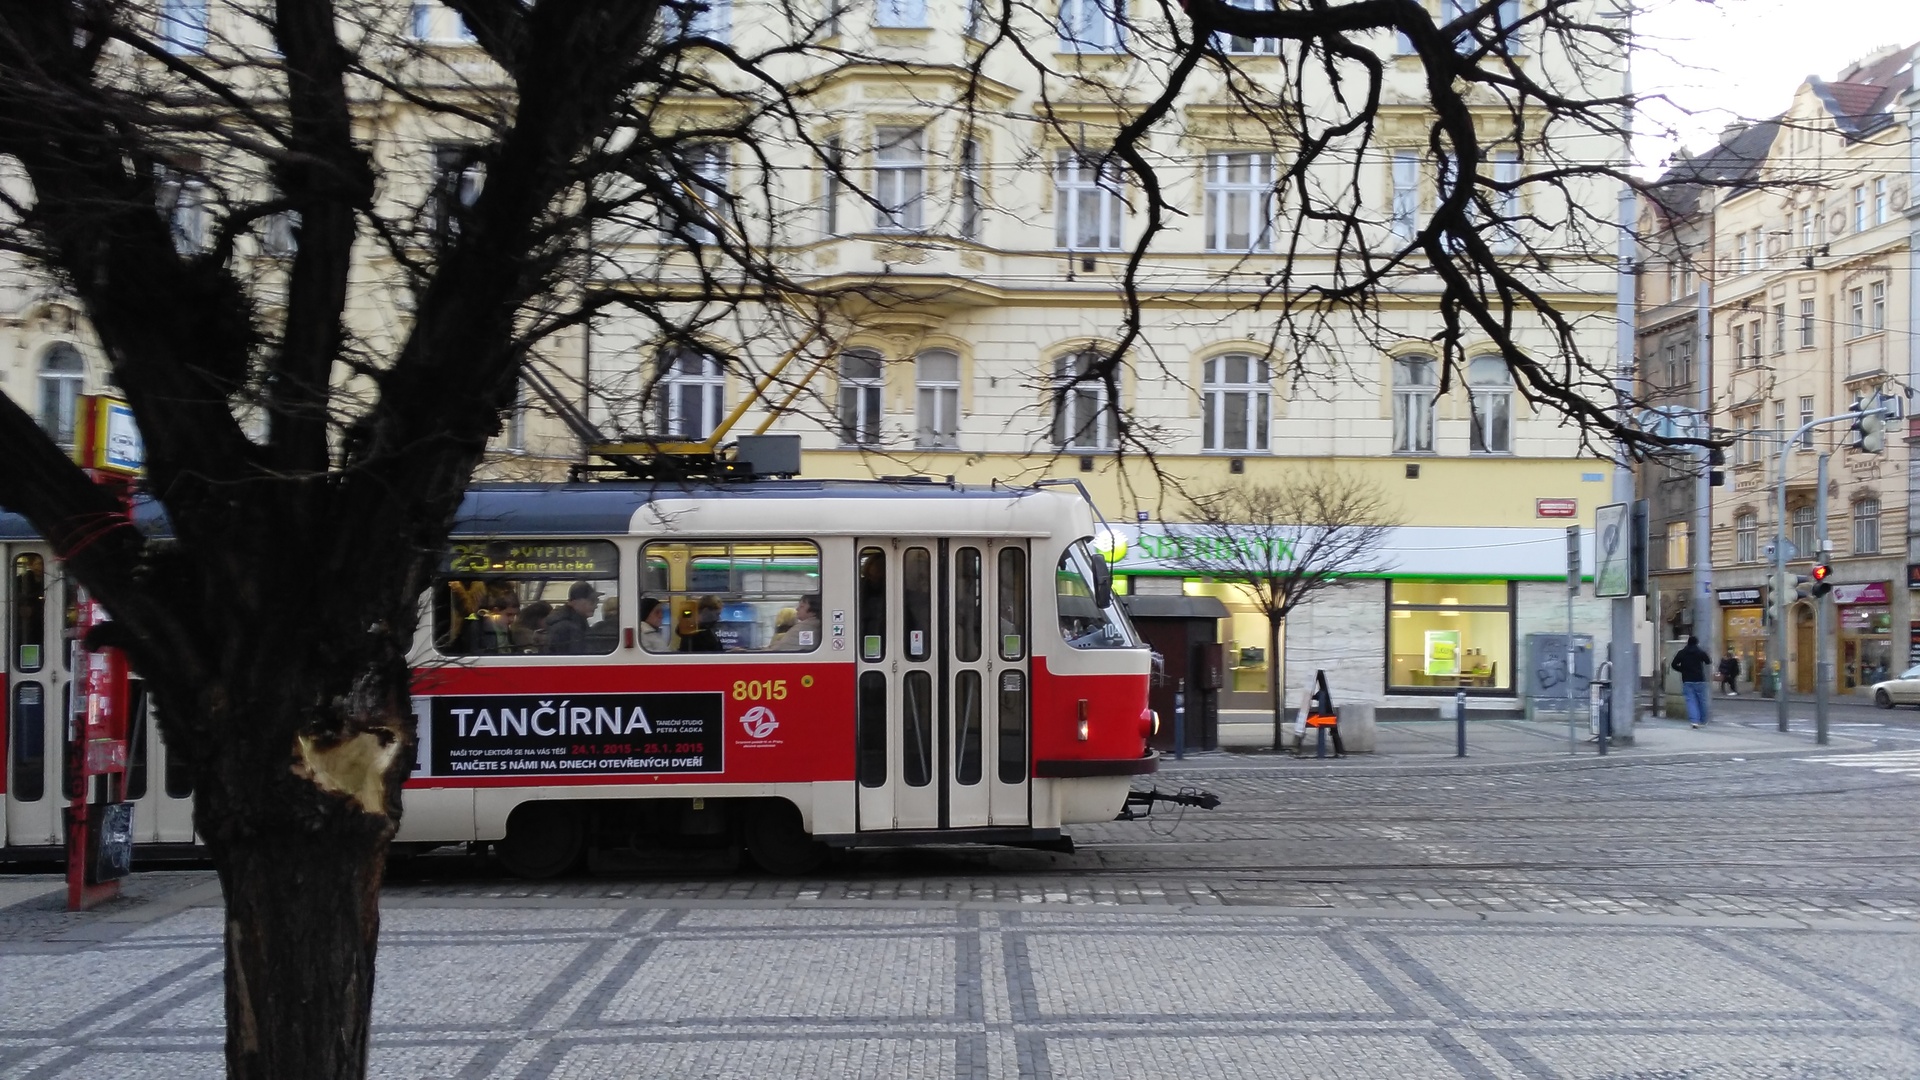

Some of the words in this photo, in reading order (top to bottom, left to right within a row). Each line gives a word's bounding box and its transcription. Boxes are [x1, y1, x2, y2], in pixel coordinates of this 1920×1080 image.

[450, 544, 491, 571] 25
[521, 546, 587, 558] VYPICH
[505, 559, 595, 571] Kamenická
[732, 680, 787, 700] 8015
[450, 700, 652, 737] TANČÍRNA
[450, 748, 467, 757] NAŠI
[468, 749, 483, 757] TOP
[484, 748, 513, 756] LEKTOŘI
[514, 748, 523, 756] SE
[525, 748, 535, 756] NA
[536, 747, 550, 755] VÁS
[571, 745, 600, 755] 24.1.
[603, 744, 632, 754] 2015
[644, 744, 673, 753] 25.1.
[676, 743, 704, 753] 2015
[450, 760, 499, 771] TANČETE
[500, 761, 507, 769] S
[509, 759, 538, 770] NÁMI
[541, 761, 557, 769] NA
[559, 760, 597, 769] DNECH
[599, 757, 669, 768] OTEVŘENÝCH
[671, 756, 703, 767] DVEŘÍ
